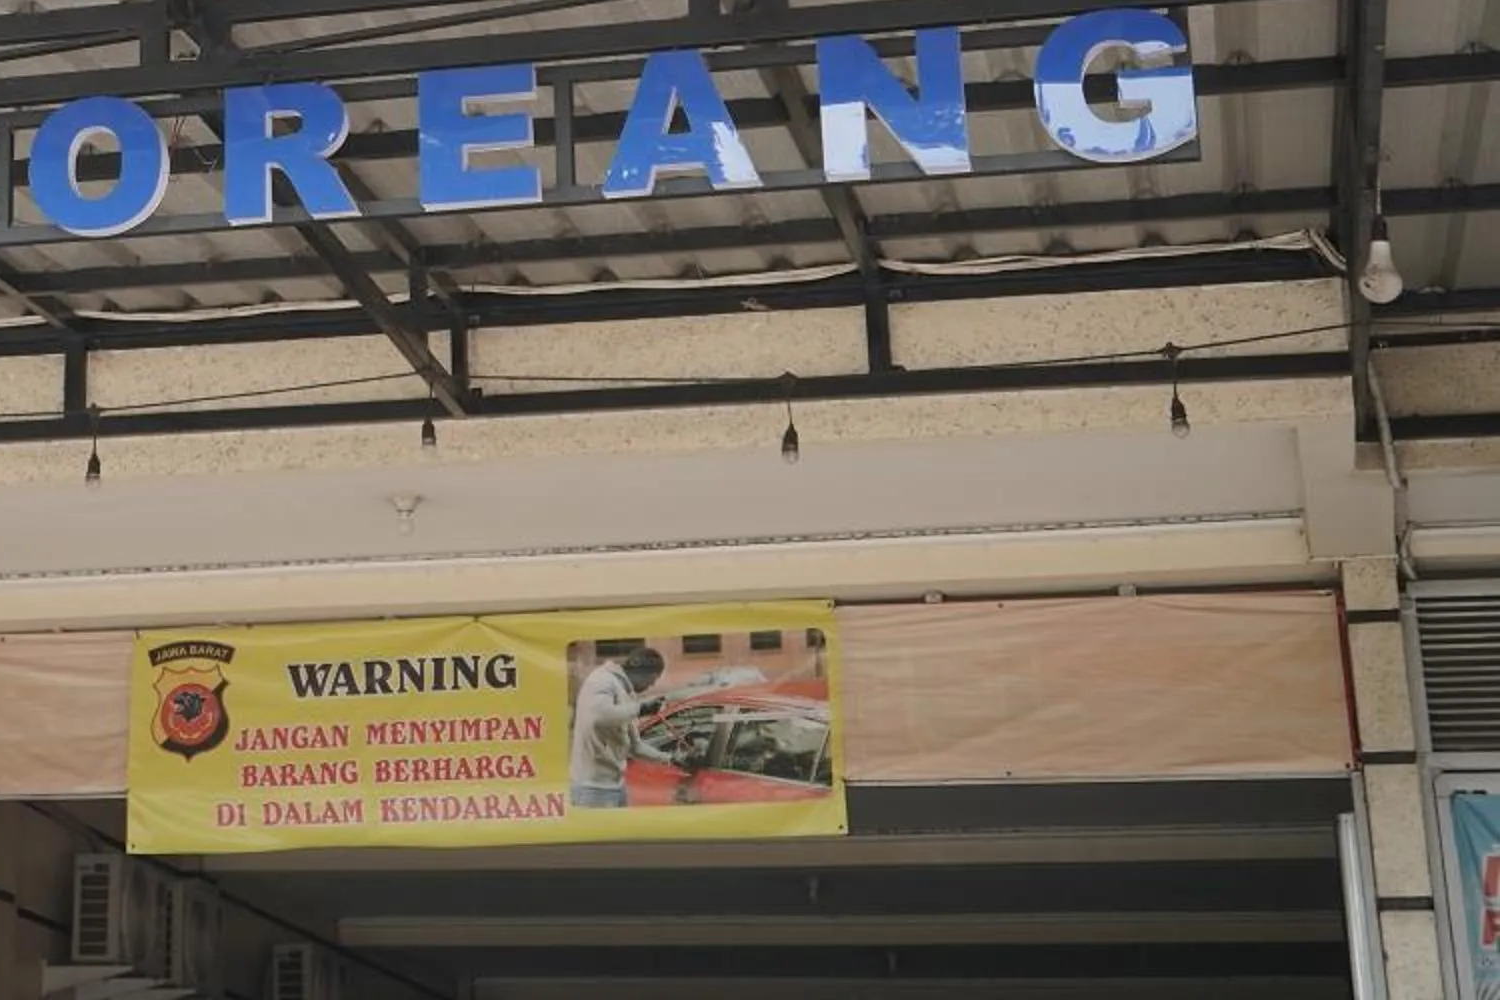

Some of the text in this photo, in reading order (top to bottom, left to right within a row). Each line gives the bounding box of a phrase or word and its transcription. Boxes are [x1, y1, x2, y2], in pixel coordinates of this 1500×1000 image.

[155, 645, 229, 662] JAWA BARAT
[288, 654, 517, 697] WARNING
[235, 716, 543, 751] JANGAN MENYIMPAN
[242, 755, 535, 787] BARANG BERHARGA
[216, 793, 565, 827] DI DALAM KENDARAAN
